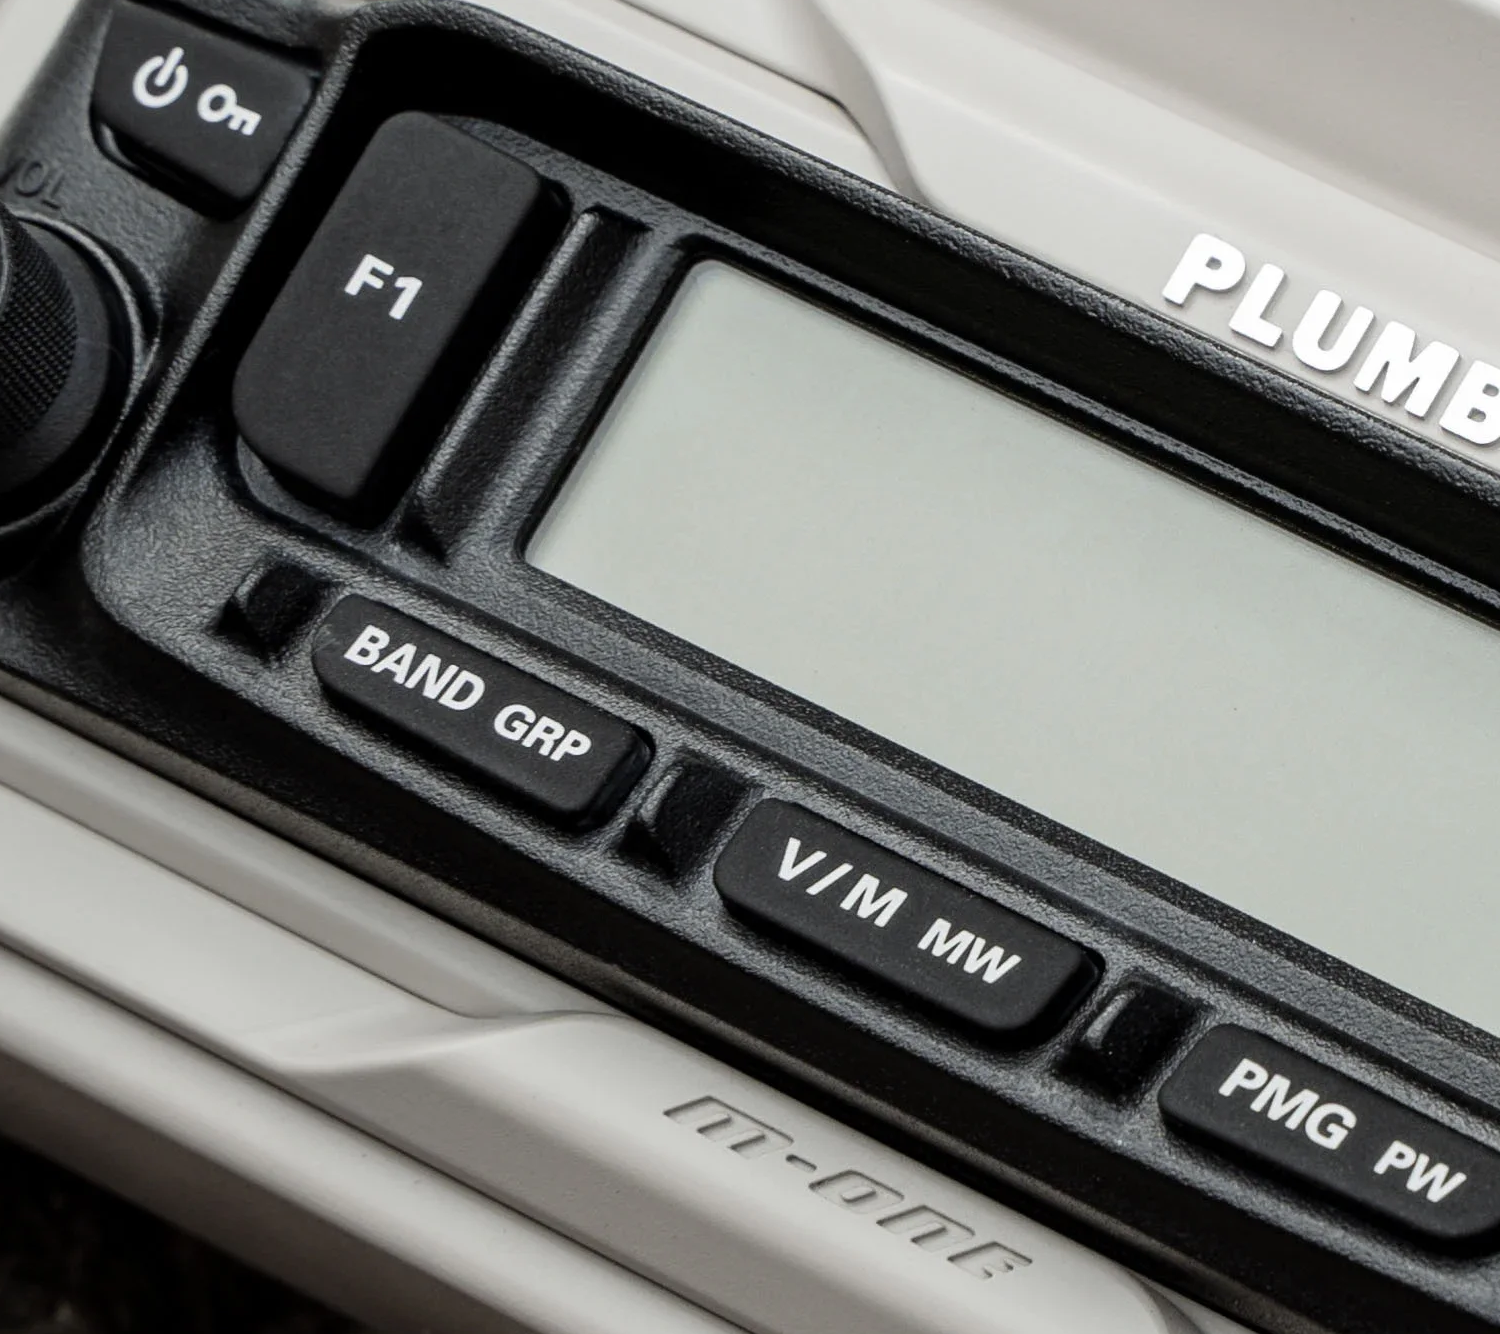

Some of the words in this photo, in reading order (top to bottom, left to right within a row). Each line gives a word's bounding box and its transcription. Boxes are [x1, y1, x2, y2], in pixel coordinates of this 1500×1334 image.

[343, 253, 423, 320] F1
[342, 623, 485, 712] BAND
[492, 703, 593, 763] GRP
[776, 836, 909, 929] V/M
[916, 917, 1023, 985] MW
[1217, 1057, 1358, 1151] PMG
[1372, 1139, 1468, 1204] PW
